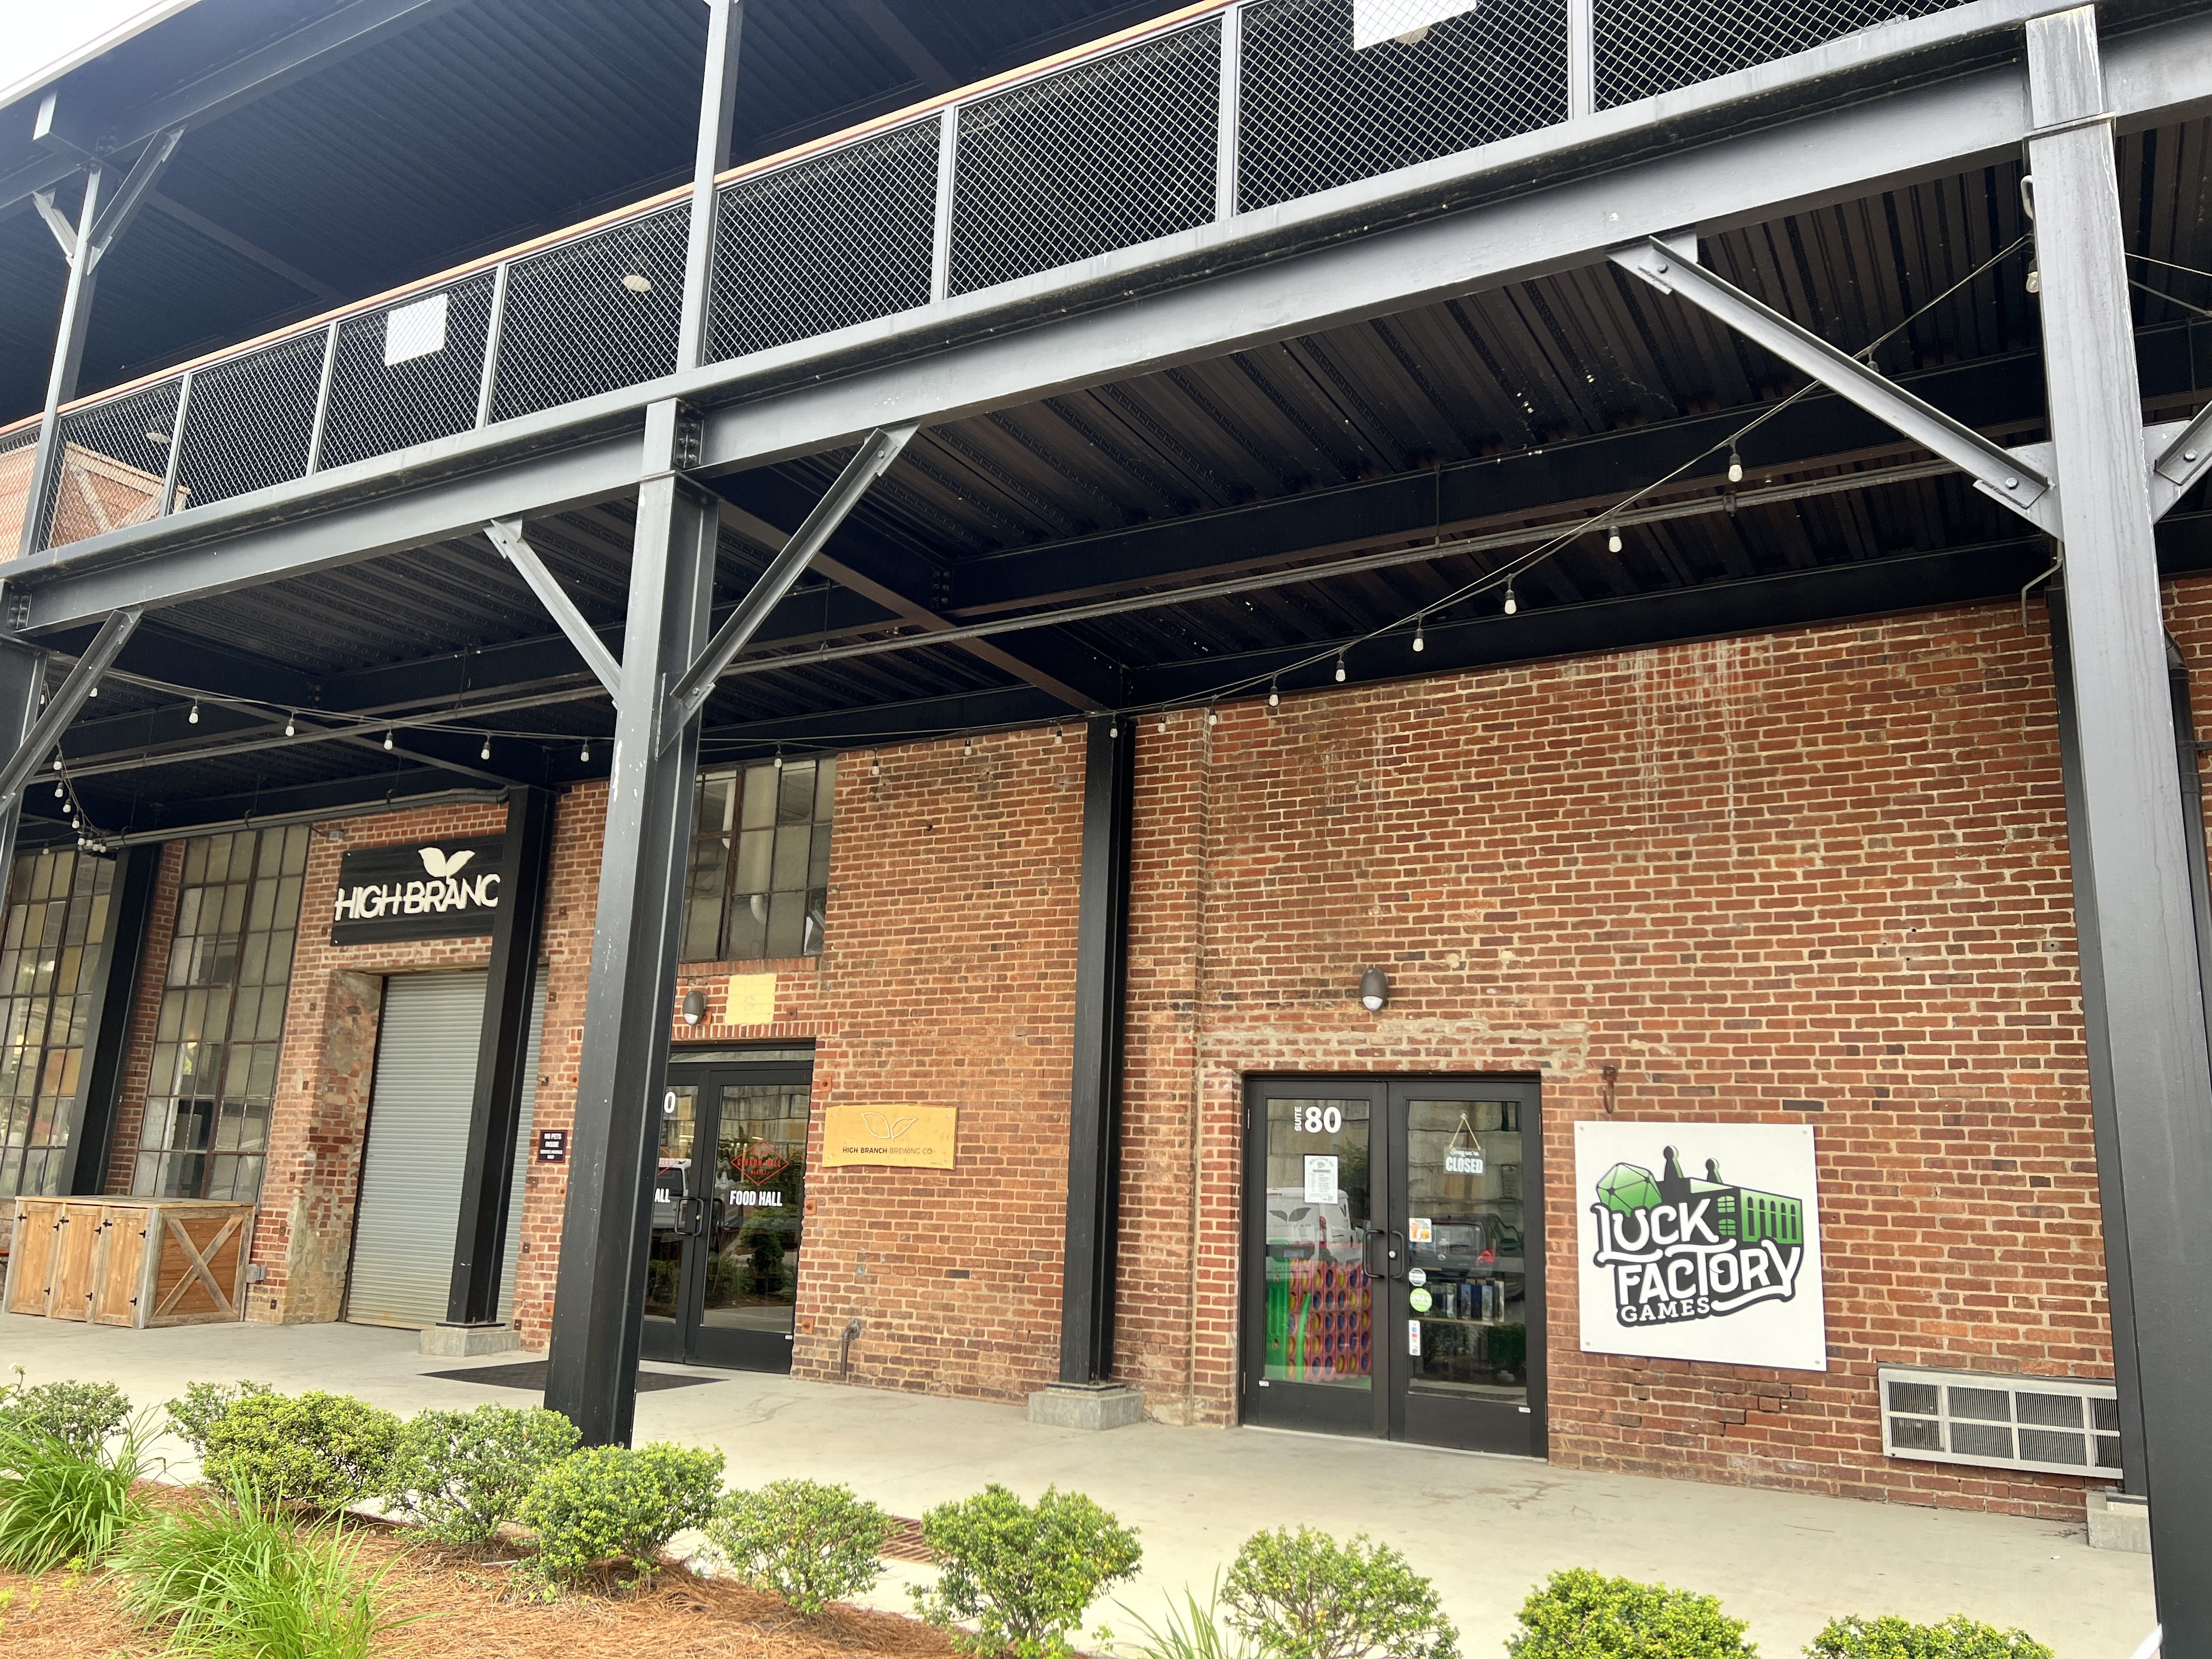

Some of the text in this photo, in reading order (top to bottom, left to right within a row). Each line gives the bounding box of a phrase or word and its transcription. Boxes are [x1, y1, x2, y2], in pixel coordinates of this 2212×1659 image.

[335, 873, 501, 921] HIGH BRANC
[1305, 1106, 1342, 1134] 80
[1445, 1156, 1484, 1174] CLOSED
[654, 1188, 670, 1203] ALL
[729, 1190, 783, 1206] FOOD HALL
[1591, 1198, 1719, 1263] LUCK
[1617, 1239, 1802, 1311] FACTORY
[1621, 1296, 1711, 1323] GAMES
